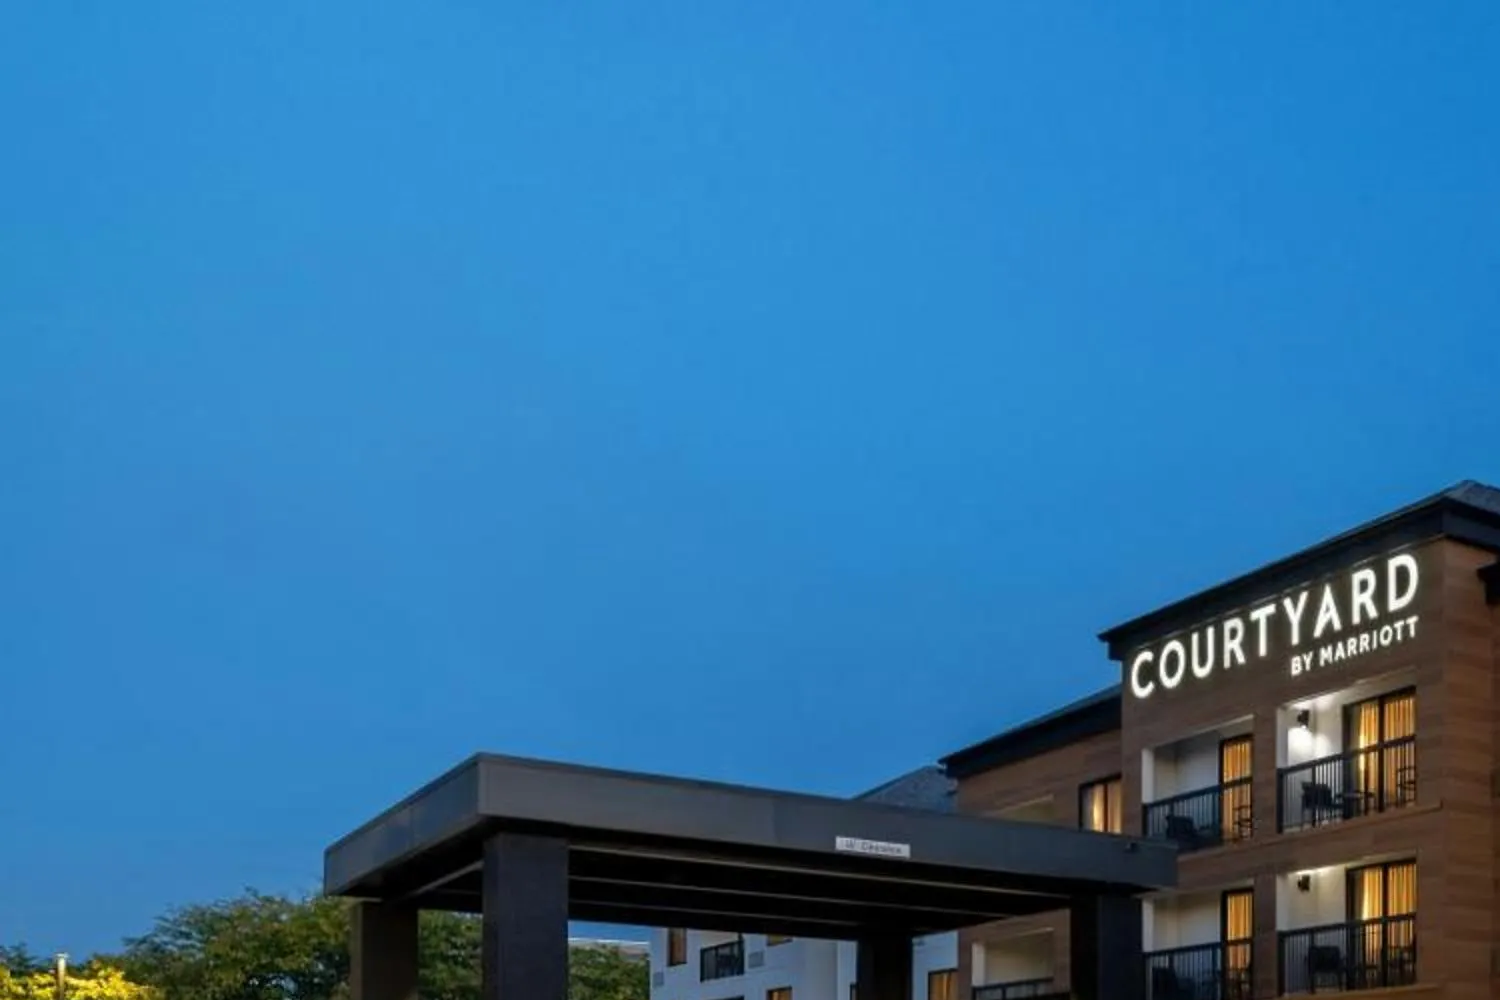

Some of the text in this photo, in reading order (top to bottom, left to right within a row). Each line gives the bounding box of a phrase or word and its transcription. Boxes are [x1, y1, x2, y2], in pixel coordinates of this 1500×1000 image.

[1130, 553, 1419, 699] COURTYARD
[1290, 615, 1419, 676] BY MARRIOTT
